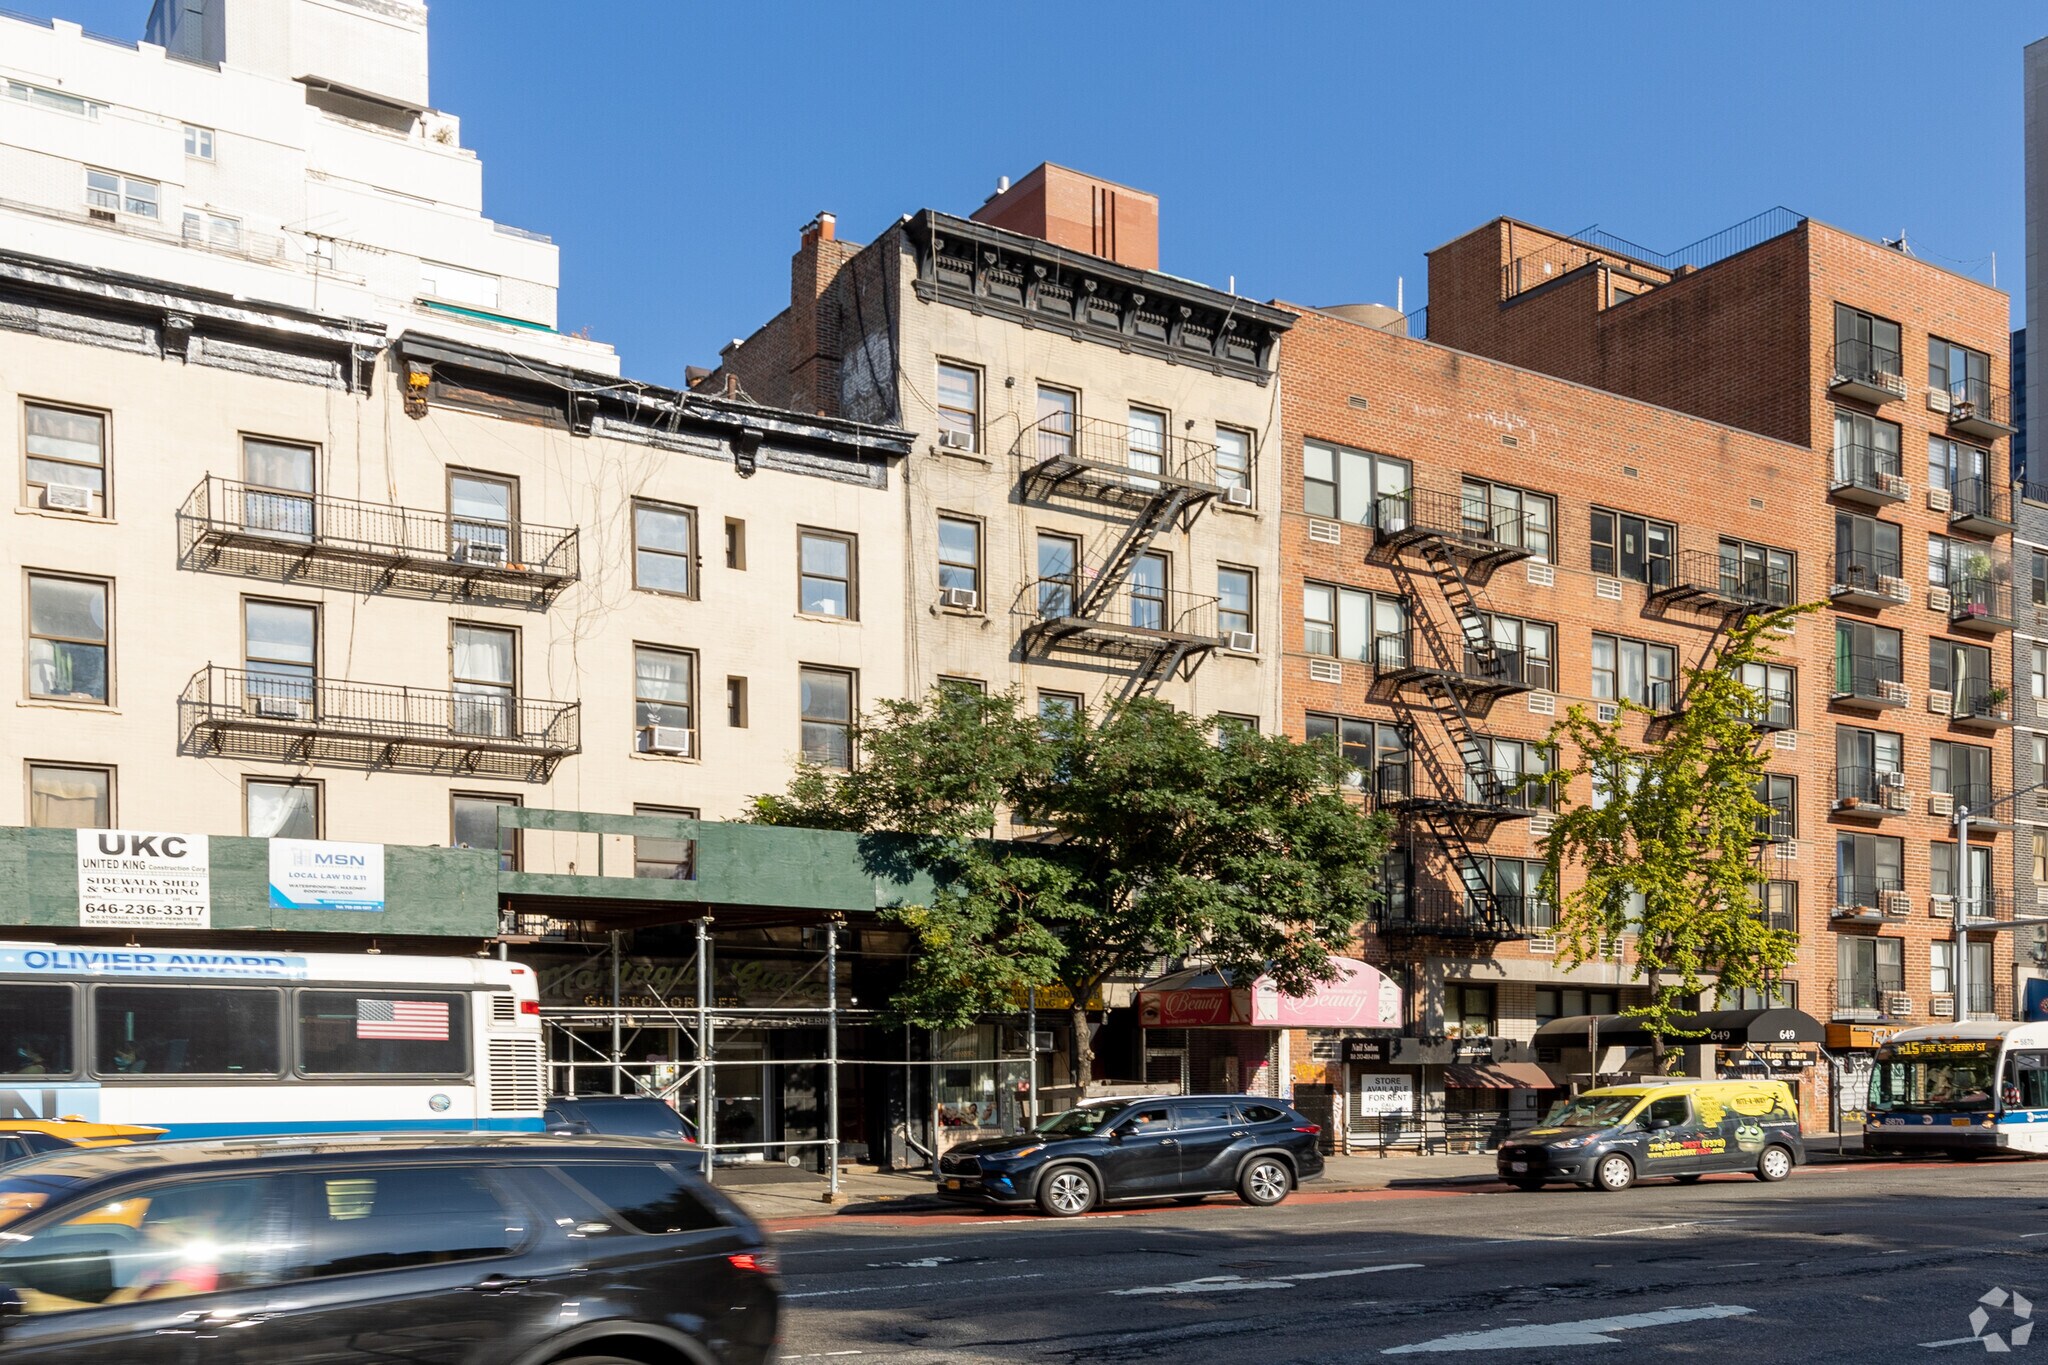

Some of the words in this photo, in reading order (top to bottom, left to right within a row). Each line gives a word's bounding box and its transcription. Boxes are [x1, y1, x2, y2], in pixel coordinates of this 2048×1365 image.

[98, 833, 187, 858] UKC
[82, 858, 119, 869] UNITED
[122, 860, 146, 870] KING
[148, 864, 190, 872] Construction
[191, 865, 206, 873] Corp
[314, 853, 365, 866] MSN
[87, 877, 158, 886] SIDEWALK
[162, 880, 199, 888] SHED
[103, 886, 198, 896] SCAFFOLDING
[85, 903, 205, 916] 646-236-3317
[24, 950, 156, 972] OLIVIER
[167, 954, 286, 974] AWARD
[1164, 992, 1224, 1024] Beauty
[1710, 1030, 1730, 1040] 649
[1779, 1029, 1796, 1040] 649
[1351, 1042, 1364, 1052] Nail
[1364, 1042, 1379, 1052] Salon
[1897, 1042, 1920, 1055] M15
[1375, 1077, 1401, 1085] STORE
[1367, 1085, 1409, 1094] AVAILABLE
[1387, 1093, 1407, 1101] RENT
